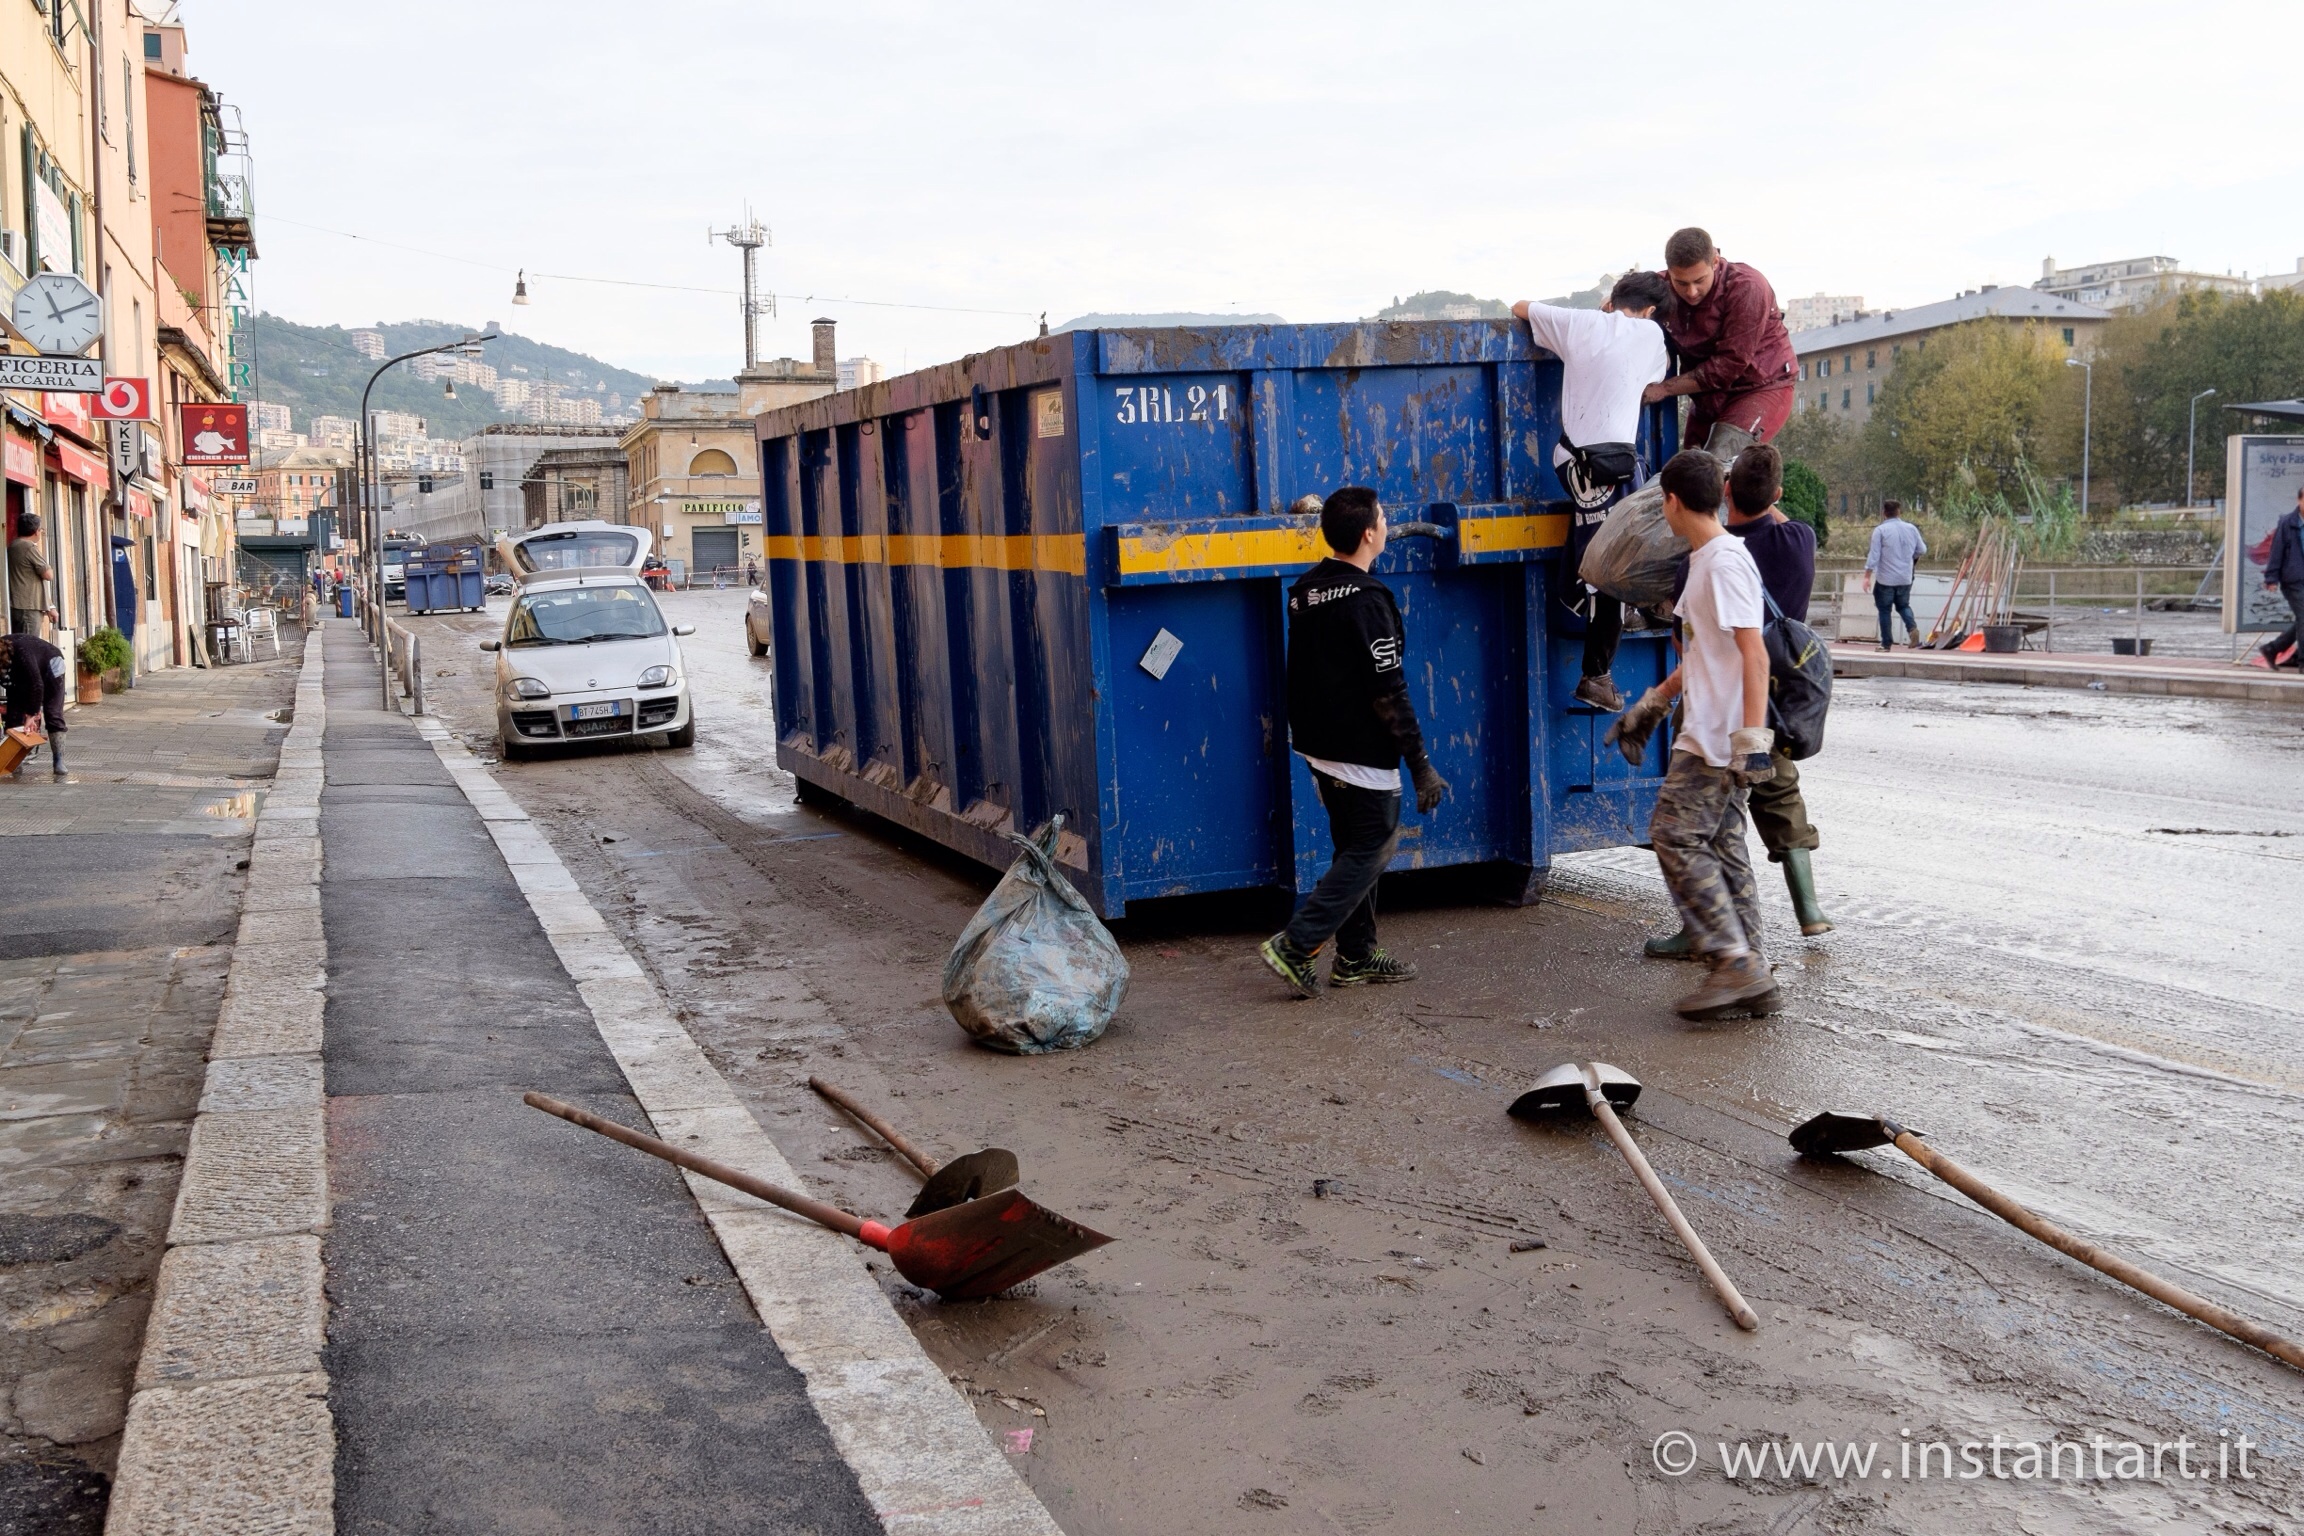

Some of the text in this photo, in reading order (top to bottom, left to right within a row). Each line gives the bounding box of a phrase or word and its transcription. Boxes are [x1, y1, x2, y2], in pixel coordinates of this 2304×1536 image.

[119, 420, 131, 466] KET
[230, 481, 254, 491] BAR
[684, 503, 745, 512] PANIFICIO
[115, 548, 125, 562] P
